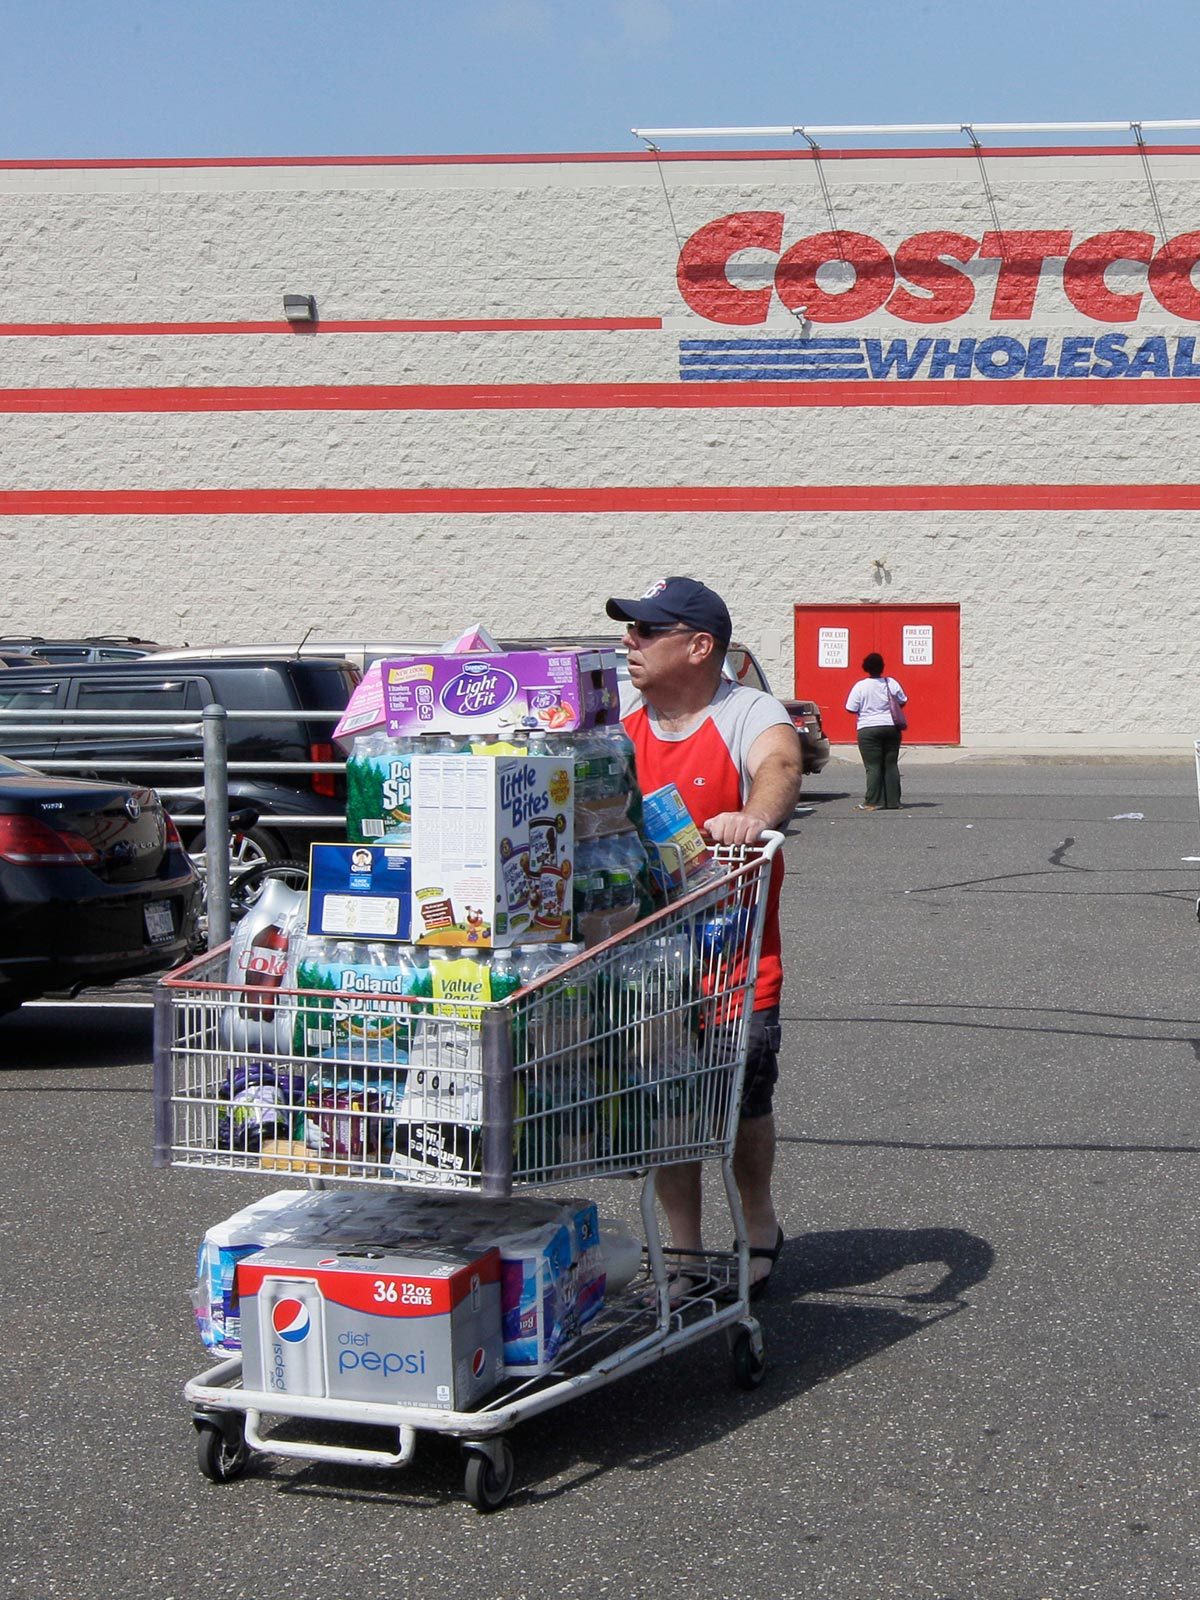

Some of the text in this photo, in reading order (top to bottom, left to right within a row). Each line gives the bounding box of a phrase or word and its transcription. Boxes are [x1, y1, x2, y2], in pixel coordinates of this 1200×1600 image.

[456, 675, 498, 698] Light
[500, 763, 536, 811] Little
[512, 790, 549, 827] Bites
[239, 950, 288, 975] Coke
[342, 971, 402, 993] Poland
[441, 979, 483, 993] Value
[373, 1280, 398, 1303] 36
[401, 1295, 433, 1306] cans
[337, 1331, 371, 1347] diet
[272, 1343, 288, 1392] pepsi
[339, 1350, 426, 1377] pepsi
